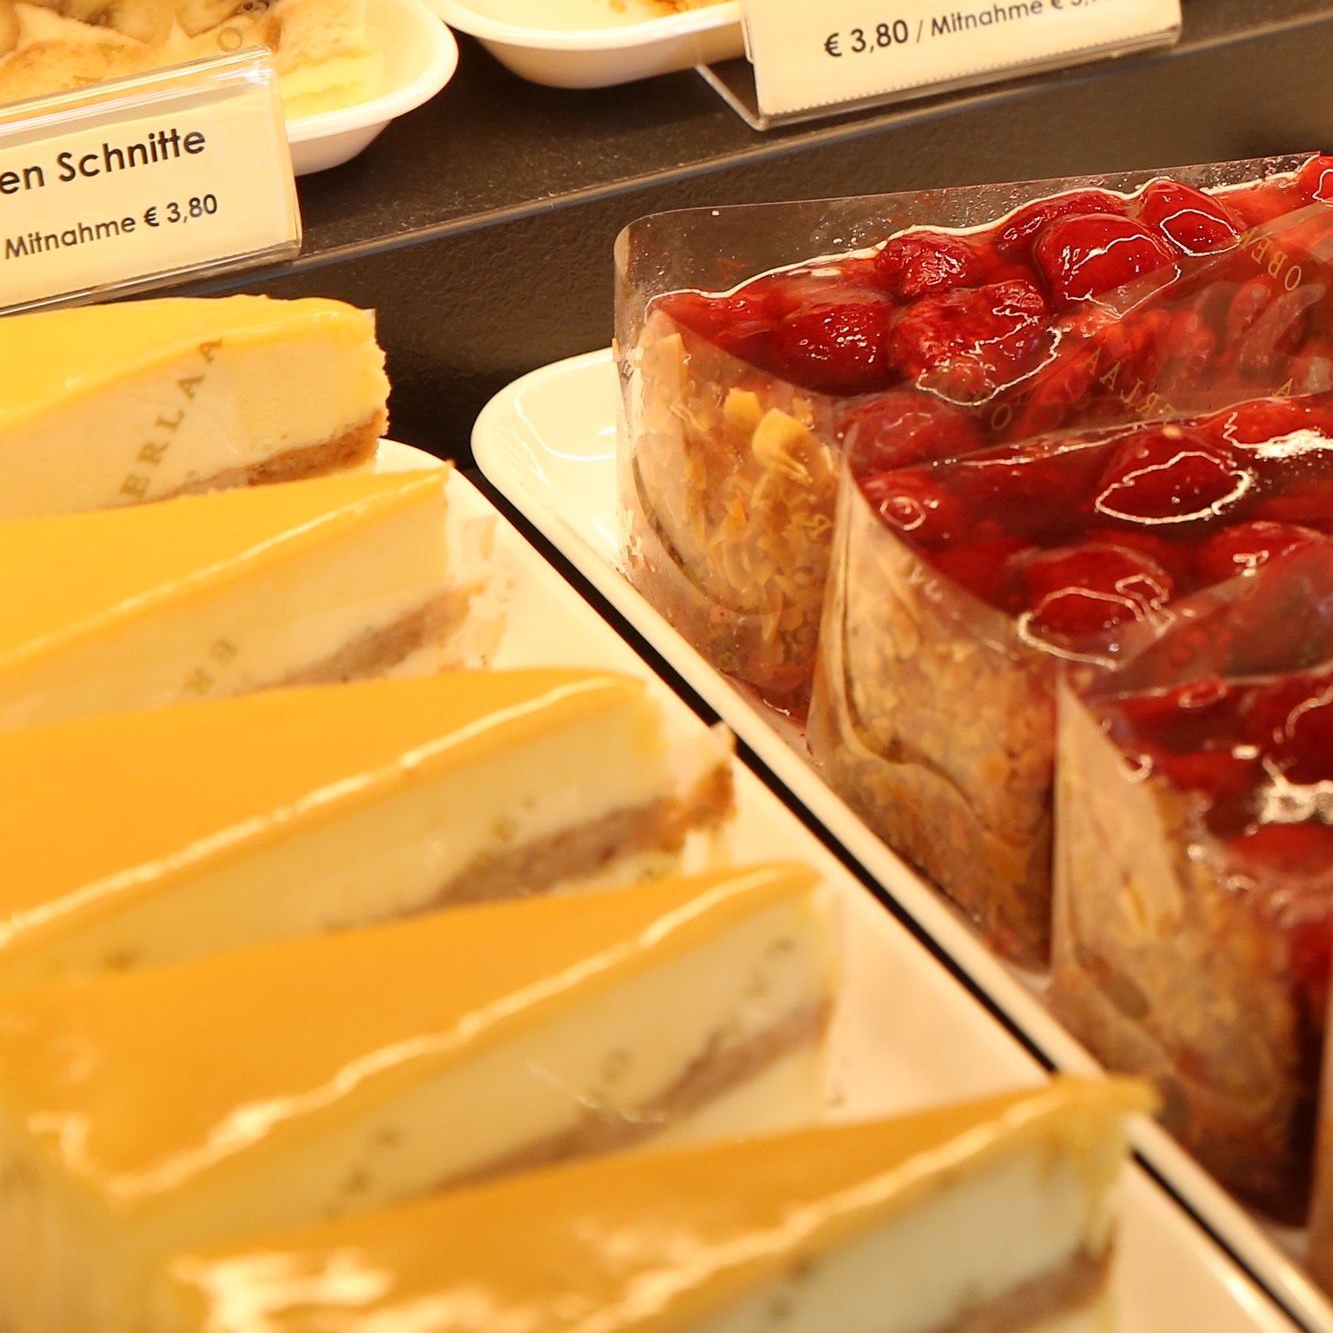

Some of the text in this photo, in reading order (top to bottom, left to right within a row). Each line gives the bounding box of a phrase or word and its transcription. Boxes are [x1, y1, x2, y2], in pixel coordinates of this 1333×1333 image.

[824, 31, 842, 58] €
[850, 18, 909, 57] 3,80
[0, 127, 206, 195] en Schnitte
[5, 193, 218, 260] Mitnahme € 3,80
[119, 336, 224, 501] ERLAA
